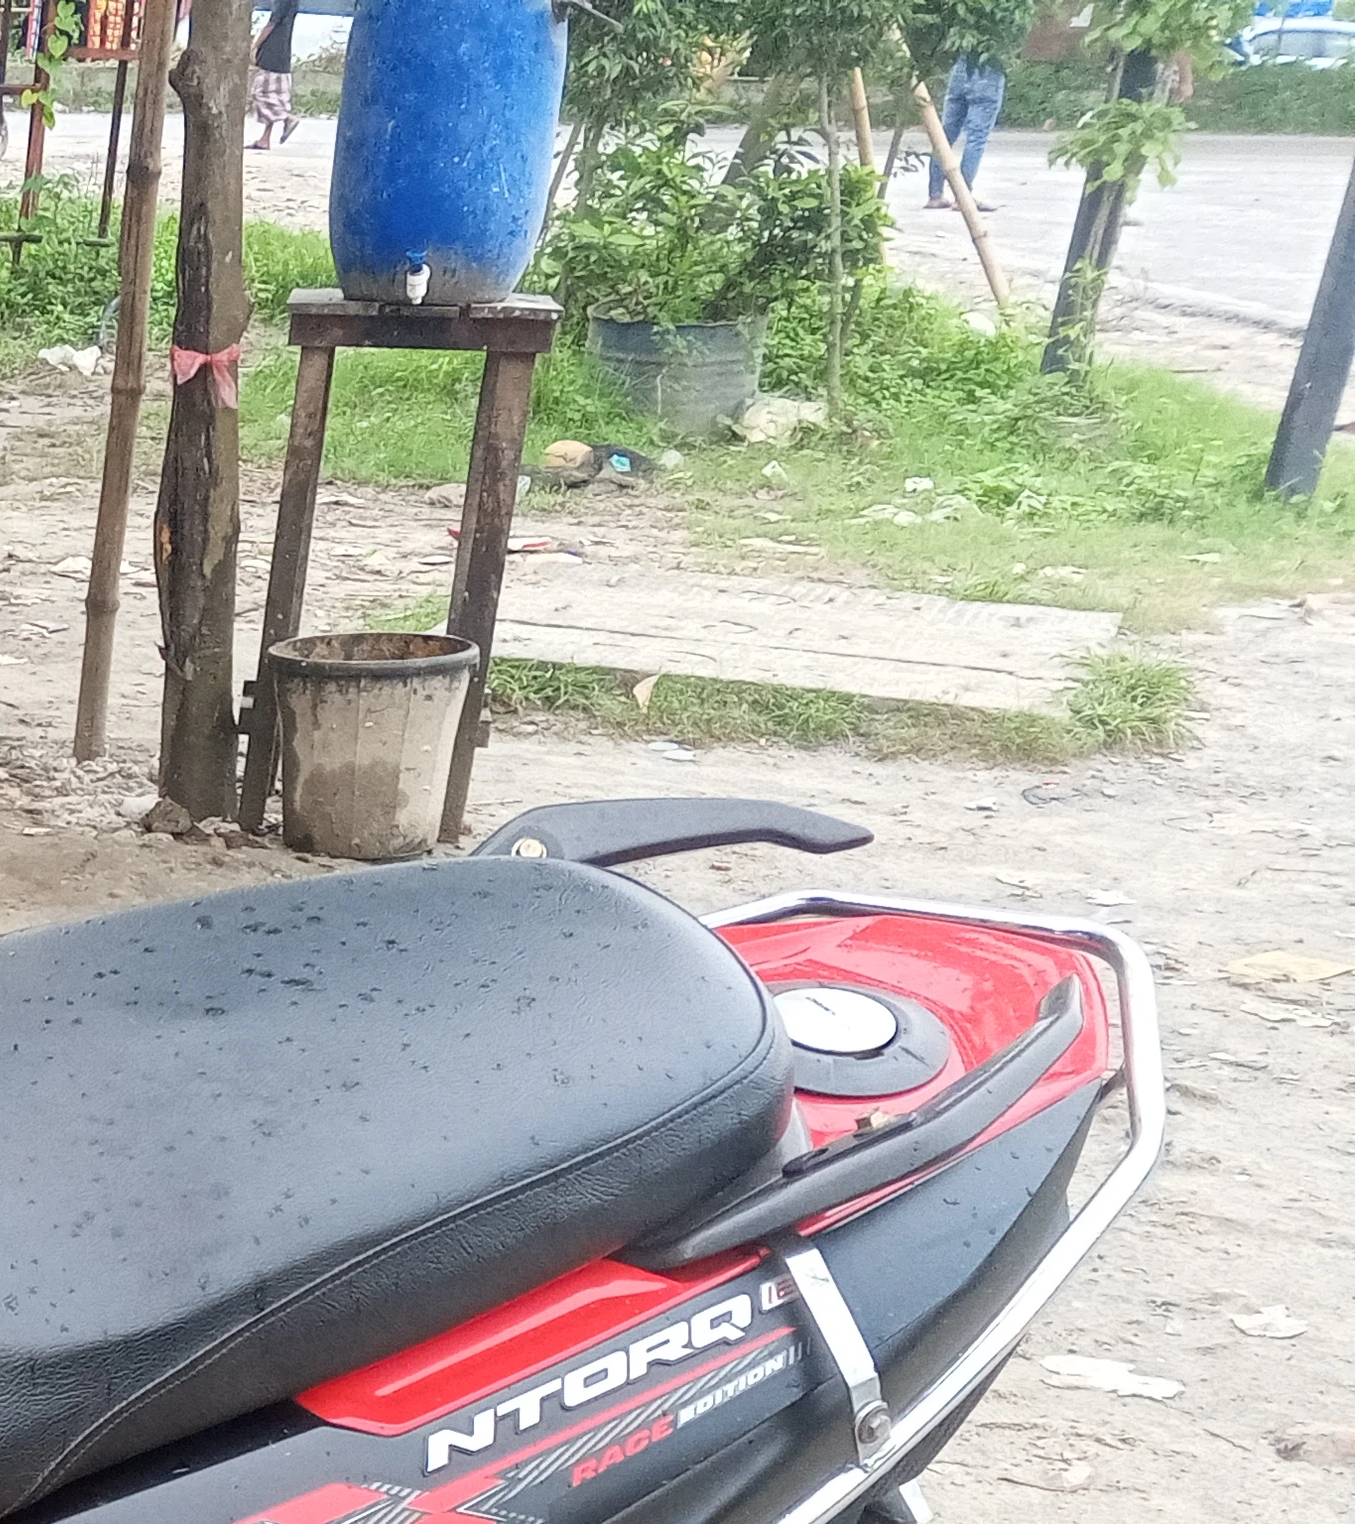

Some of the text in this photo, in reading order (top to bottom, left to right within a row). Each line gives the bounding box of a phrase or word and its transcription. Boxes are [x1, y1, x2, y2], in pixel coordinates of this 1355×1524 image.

[425, 1294, 752, 1473] NTORQ
[570, 1352, 784, 1488] RACE EDITION
